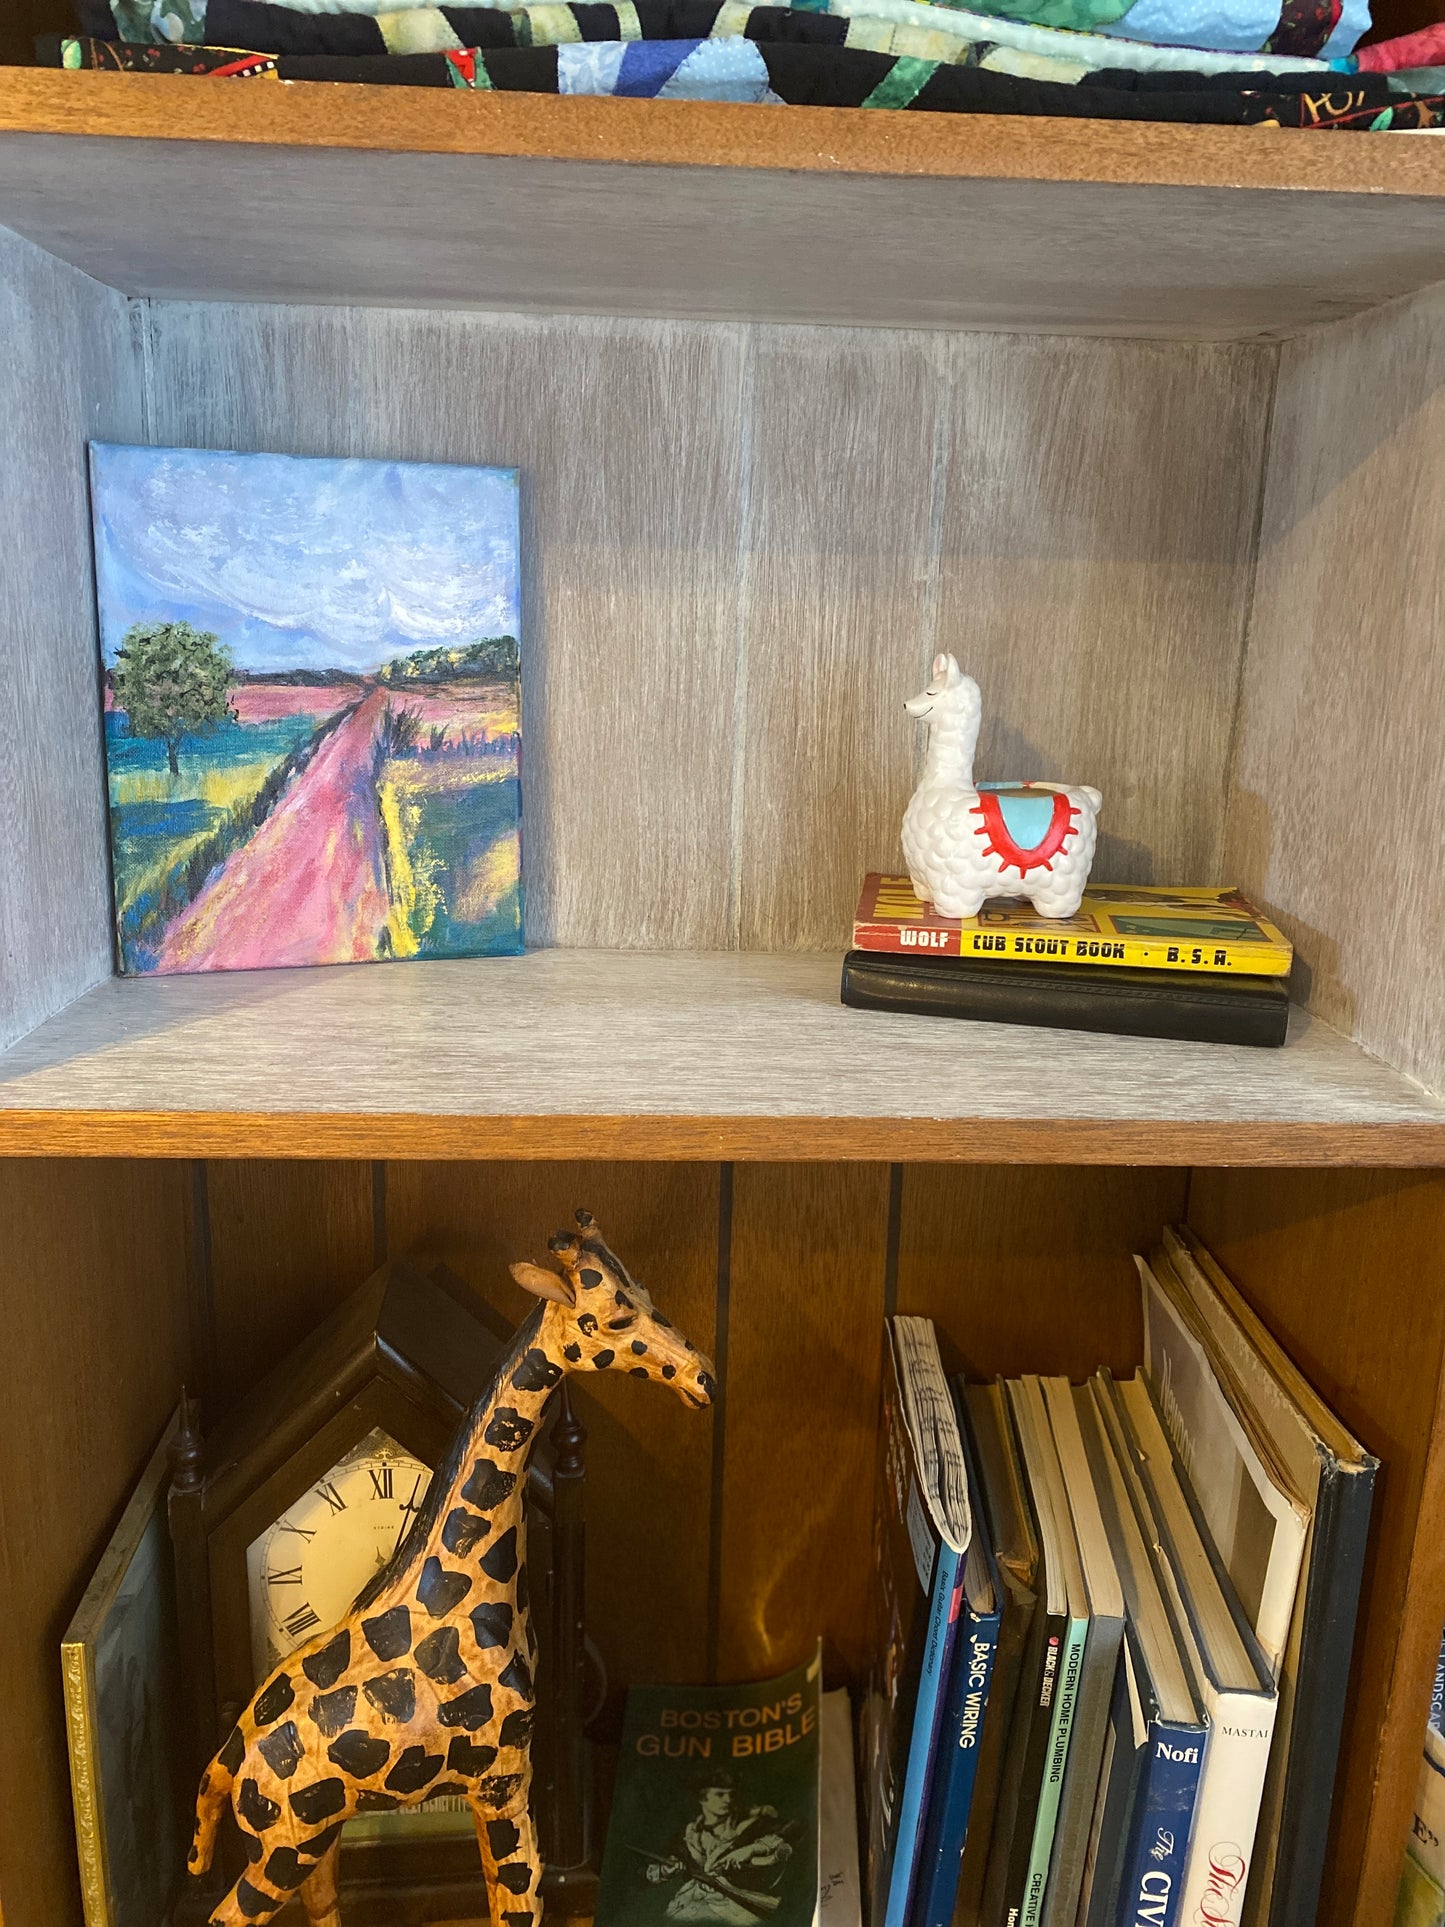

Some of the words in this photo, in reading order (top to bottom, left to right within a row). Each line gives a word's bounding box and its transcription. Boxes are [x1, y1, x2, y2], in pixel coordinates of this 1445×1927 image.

[899, 929, 950, 948] WOLF
[972, 934, 1007, 952] CUB
[1014, 937, 1070, 956] SCOUT
[1076, 940, 1126, 959] BOOK
[313, 1481, 349, 1517] XI
[367, 1468, 395, 1501] XII
[279, 1519, 318, 1544] X
[932, 1616, 941, 1641] Chord
[926, 1641, 938, 1677] Dictionary
[968, 1642, 990, 1688] BASIC
[1064, 1643, 1081, 1691] MODERN
[660, 1692, 802, 1729] BOSTON'S
[959, 1691, 983, 1749] WIRING
[1059, 1693, 1073, 1726] HOME
[635, 1734, 712, 1758] GUN
[731, 1705, 817, 1758] BIBLE
[1221, 1726, 1270, 1739] MASTAI
[1050, 1728, 1067, 1783] PLUMBING
[1155, 1741, 1199, 1764] Nofi
[1148, 1827, 1174, 1862] The
[1204, 1841, 1246, 1901] The
[1025, 1873, 1042, 1922] CREATIVE
[1135, 1870, 1172, 1927] CIV
